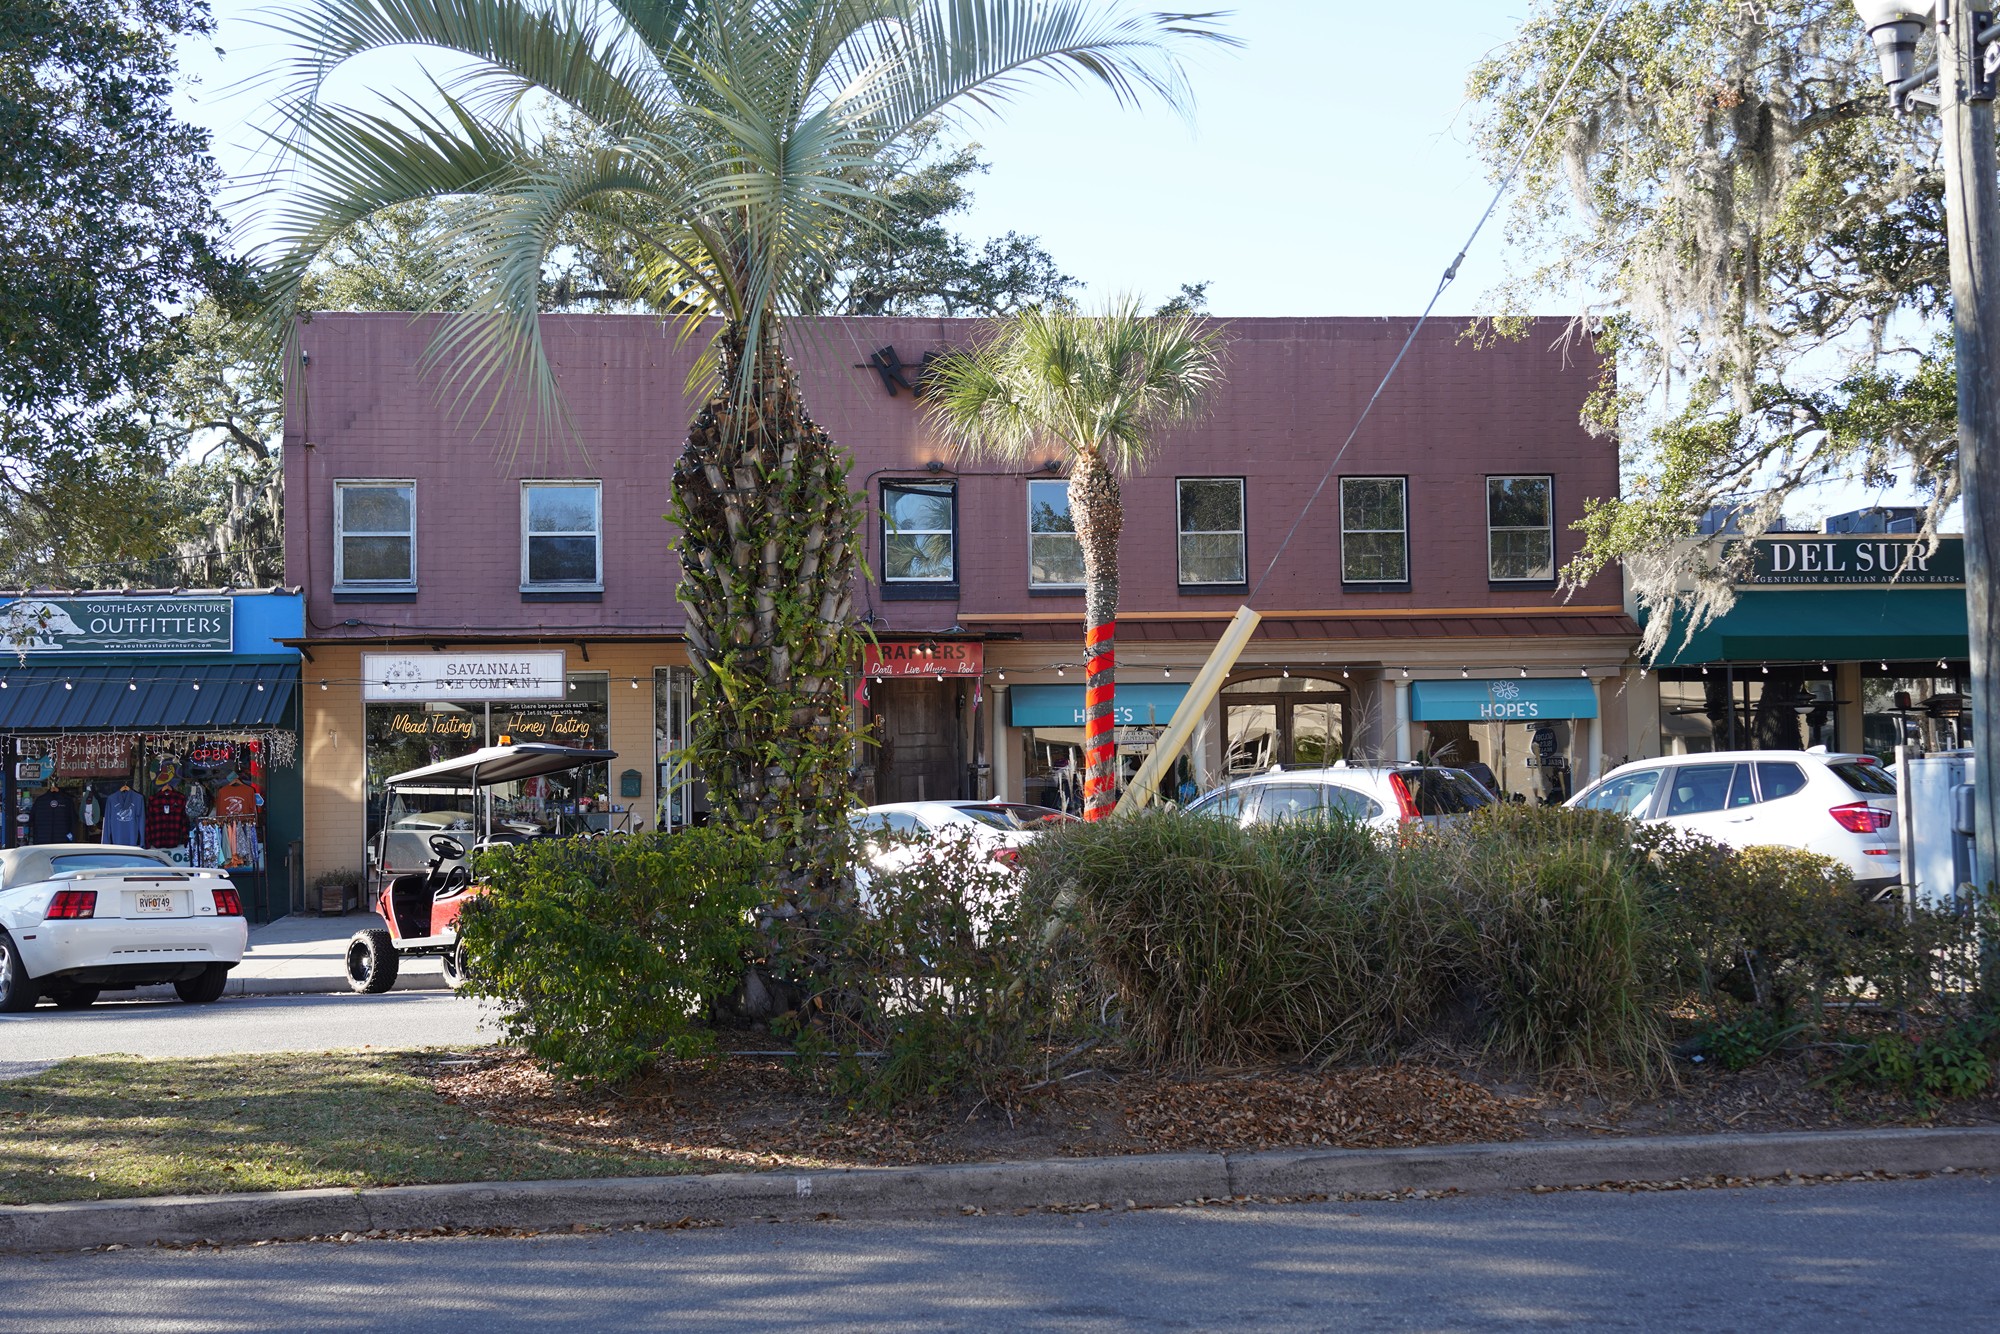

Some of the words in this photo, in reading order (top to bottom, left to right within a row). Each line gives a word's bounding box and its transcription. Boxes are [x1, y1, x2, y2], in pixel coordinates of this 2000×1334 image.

[1770, 543, 1846, 572] DEL
[1856, 542, 1929, 572] SUR
[86, 603, 154, 613] SOUTHEAST
[156, 603, 226, 613] ADVENTURE
[90, 617, 221, 634] OUTFITTERS
[881, 645, 966, 660] RAFTERS
[446, 662, 532, 676] SAVANNAH
[871, 662, 893, 675] Darts
[904, 662, 921, 674] Live
[957, 661, 976, 674] Pool
[469, 677, 542, 689] COMPANY
[1074, 707, 1134, 722] HE'S
[1480, 701, 1539, 717] HOPE'S
[390, 713, 428, 734] Mead
[431, 713, 473, 739] Tasting
[507, 711, 546, 737] Honey
[550, 714, 590, 738] Tasting
[193, 749, 229, 761] OPEN
[61, 758, 96, 771] Explore
[98, 758, 128, 769] Global
[140, 897, 170, 908] RVF0749
